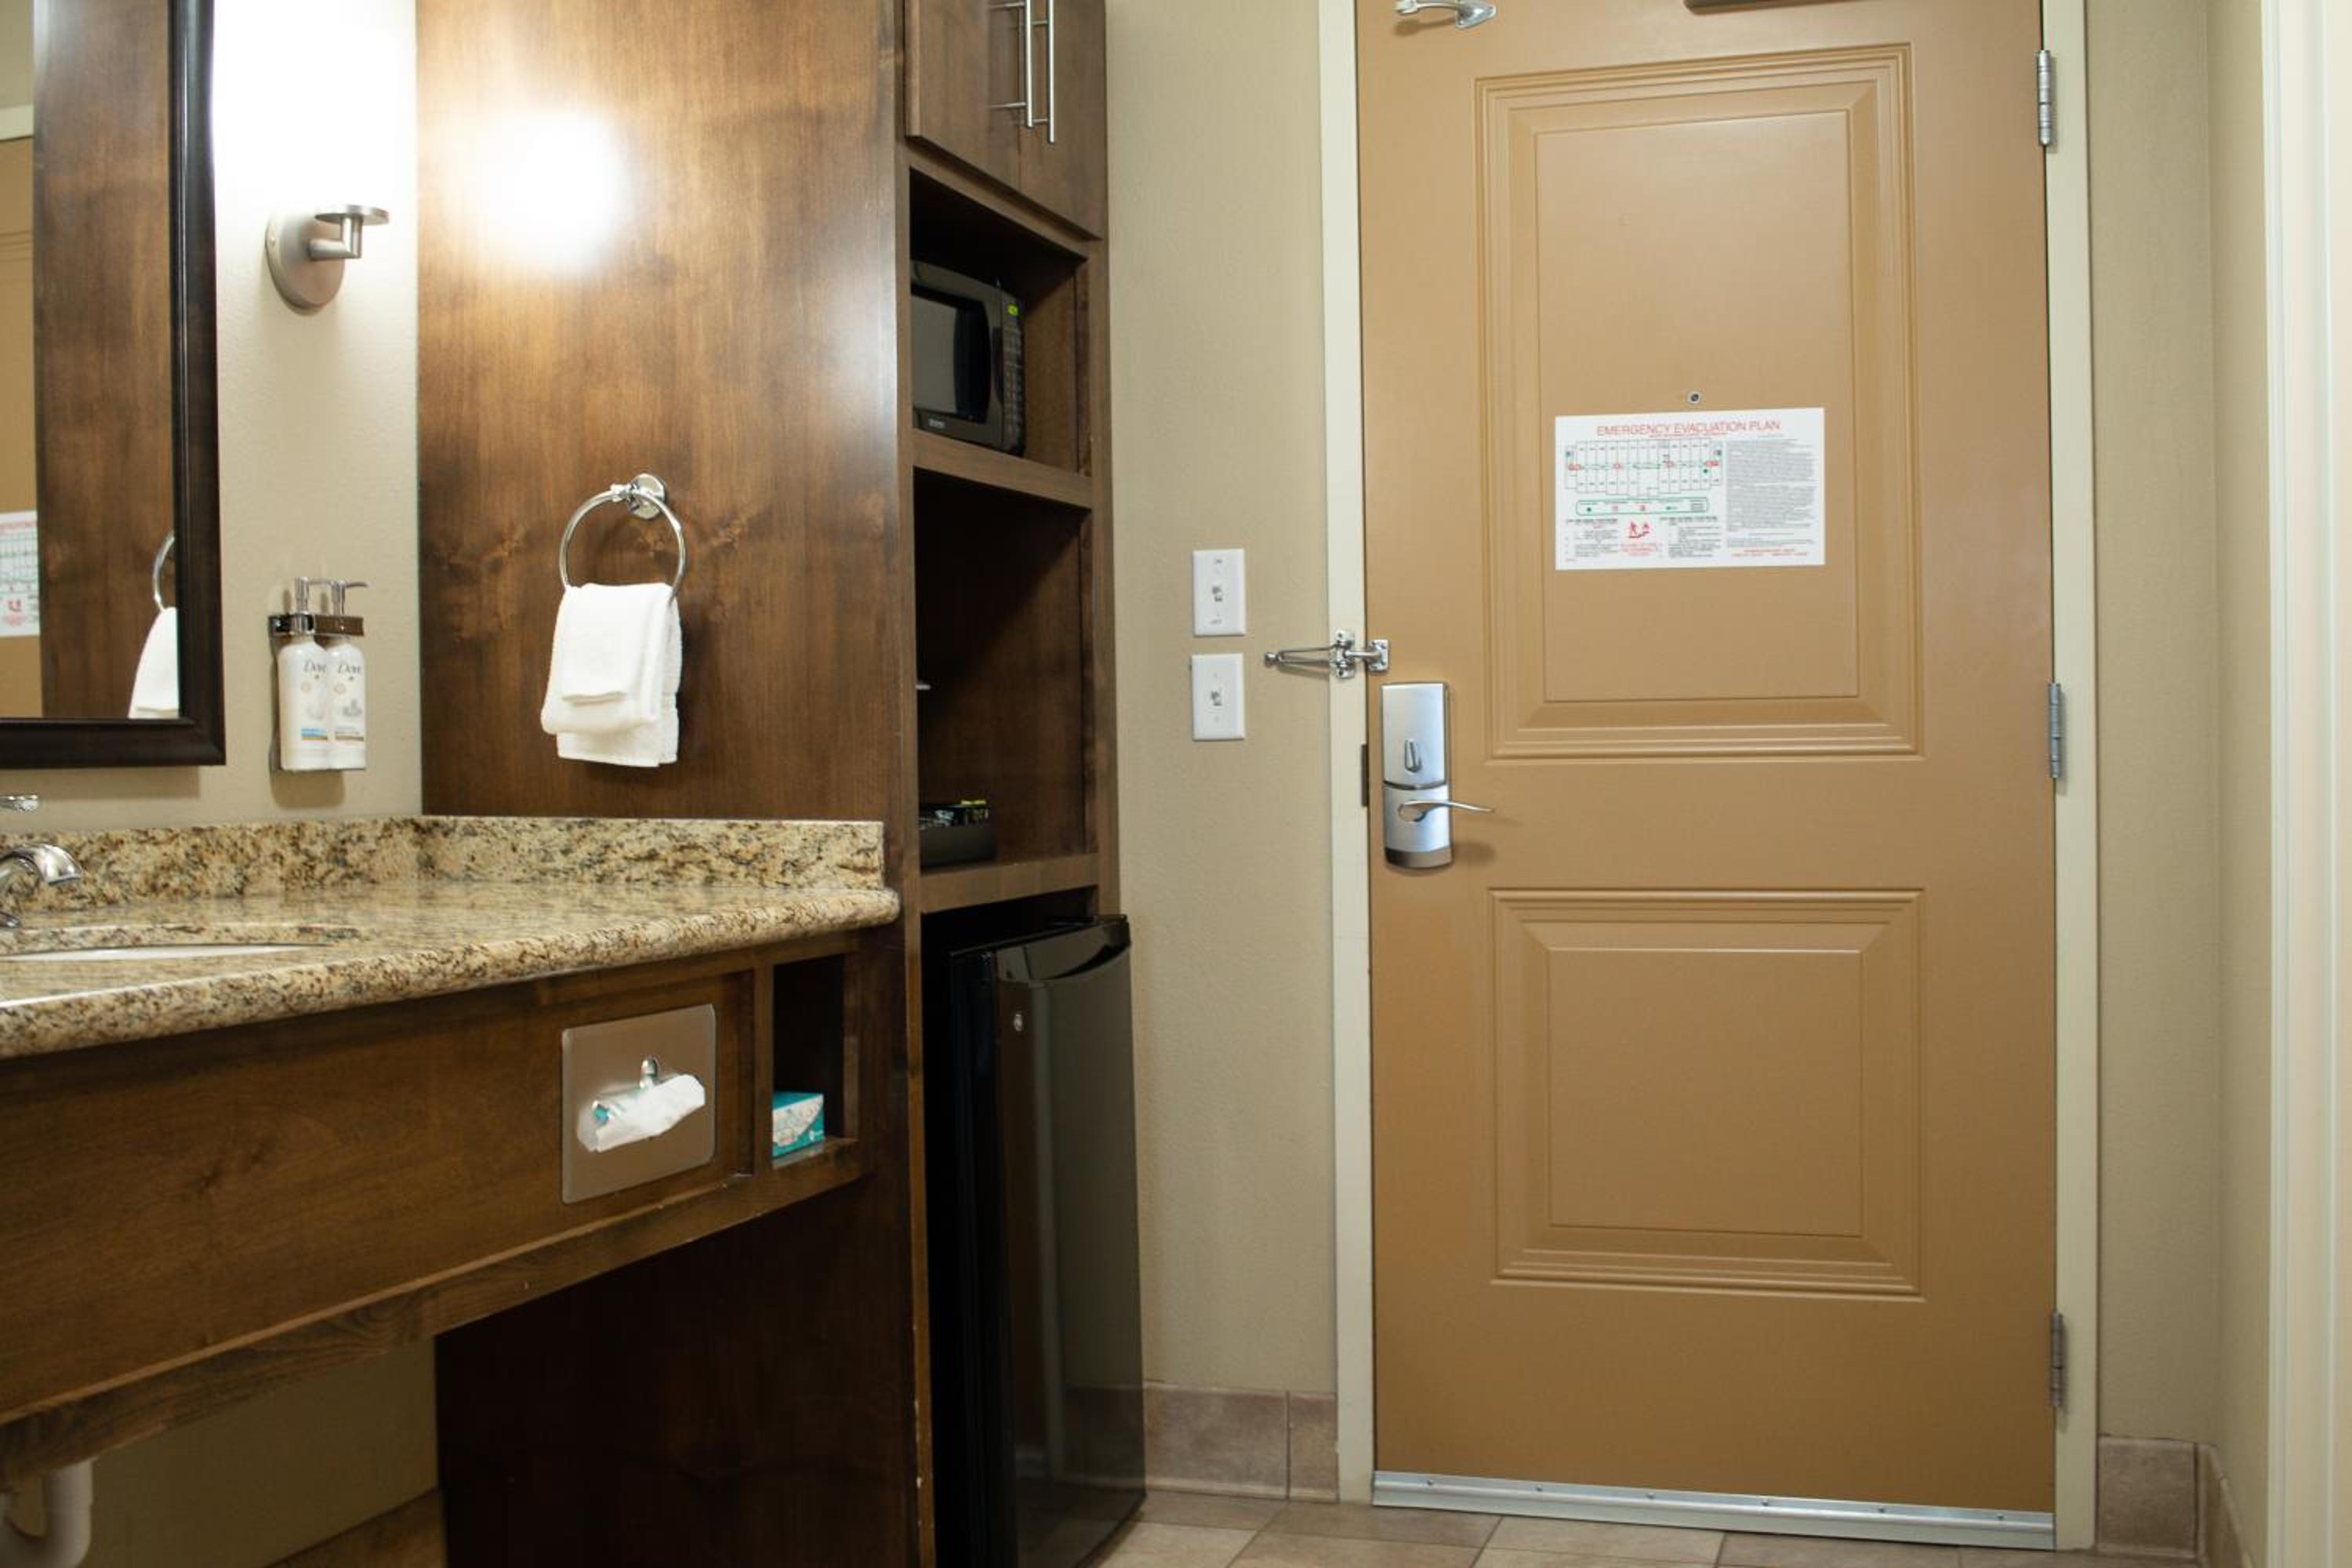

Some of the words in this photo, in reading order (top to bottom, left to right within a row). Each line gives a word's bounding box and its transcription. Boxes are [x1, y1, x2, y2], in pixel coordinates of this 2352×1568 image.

[1597, 424, 1670, 437] EMERGENCY
[1675, 422, 1746, 434] EVACUATION
[1749, 421, 1780, 431] PLAN
